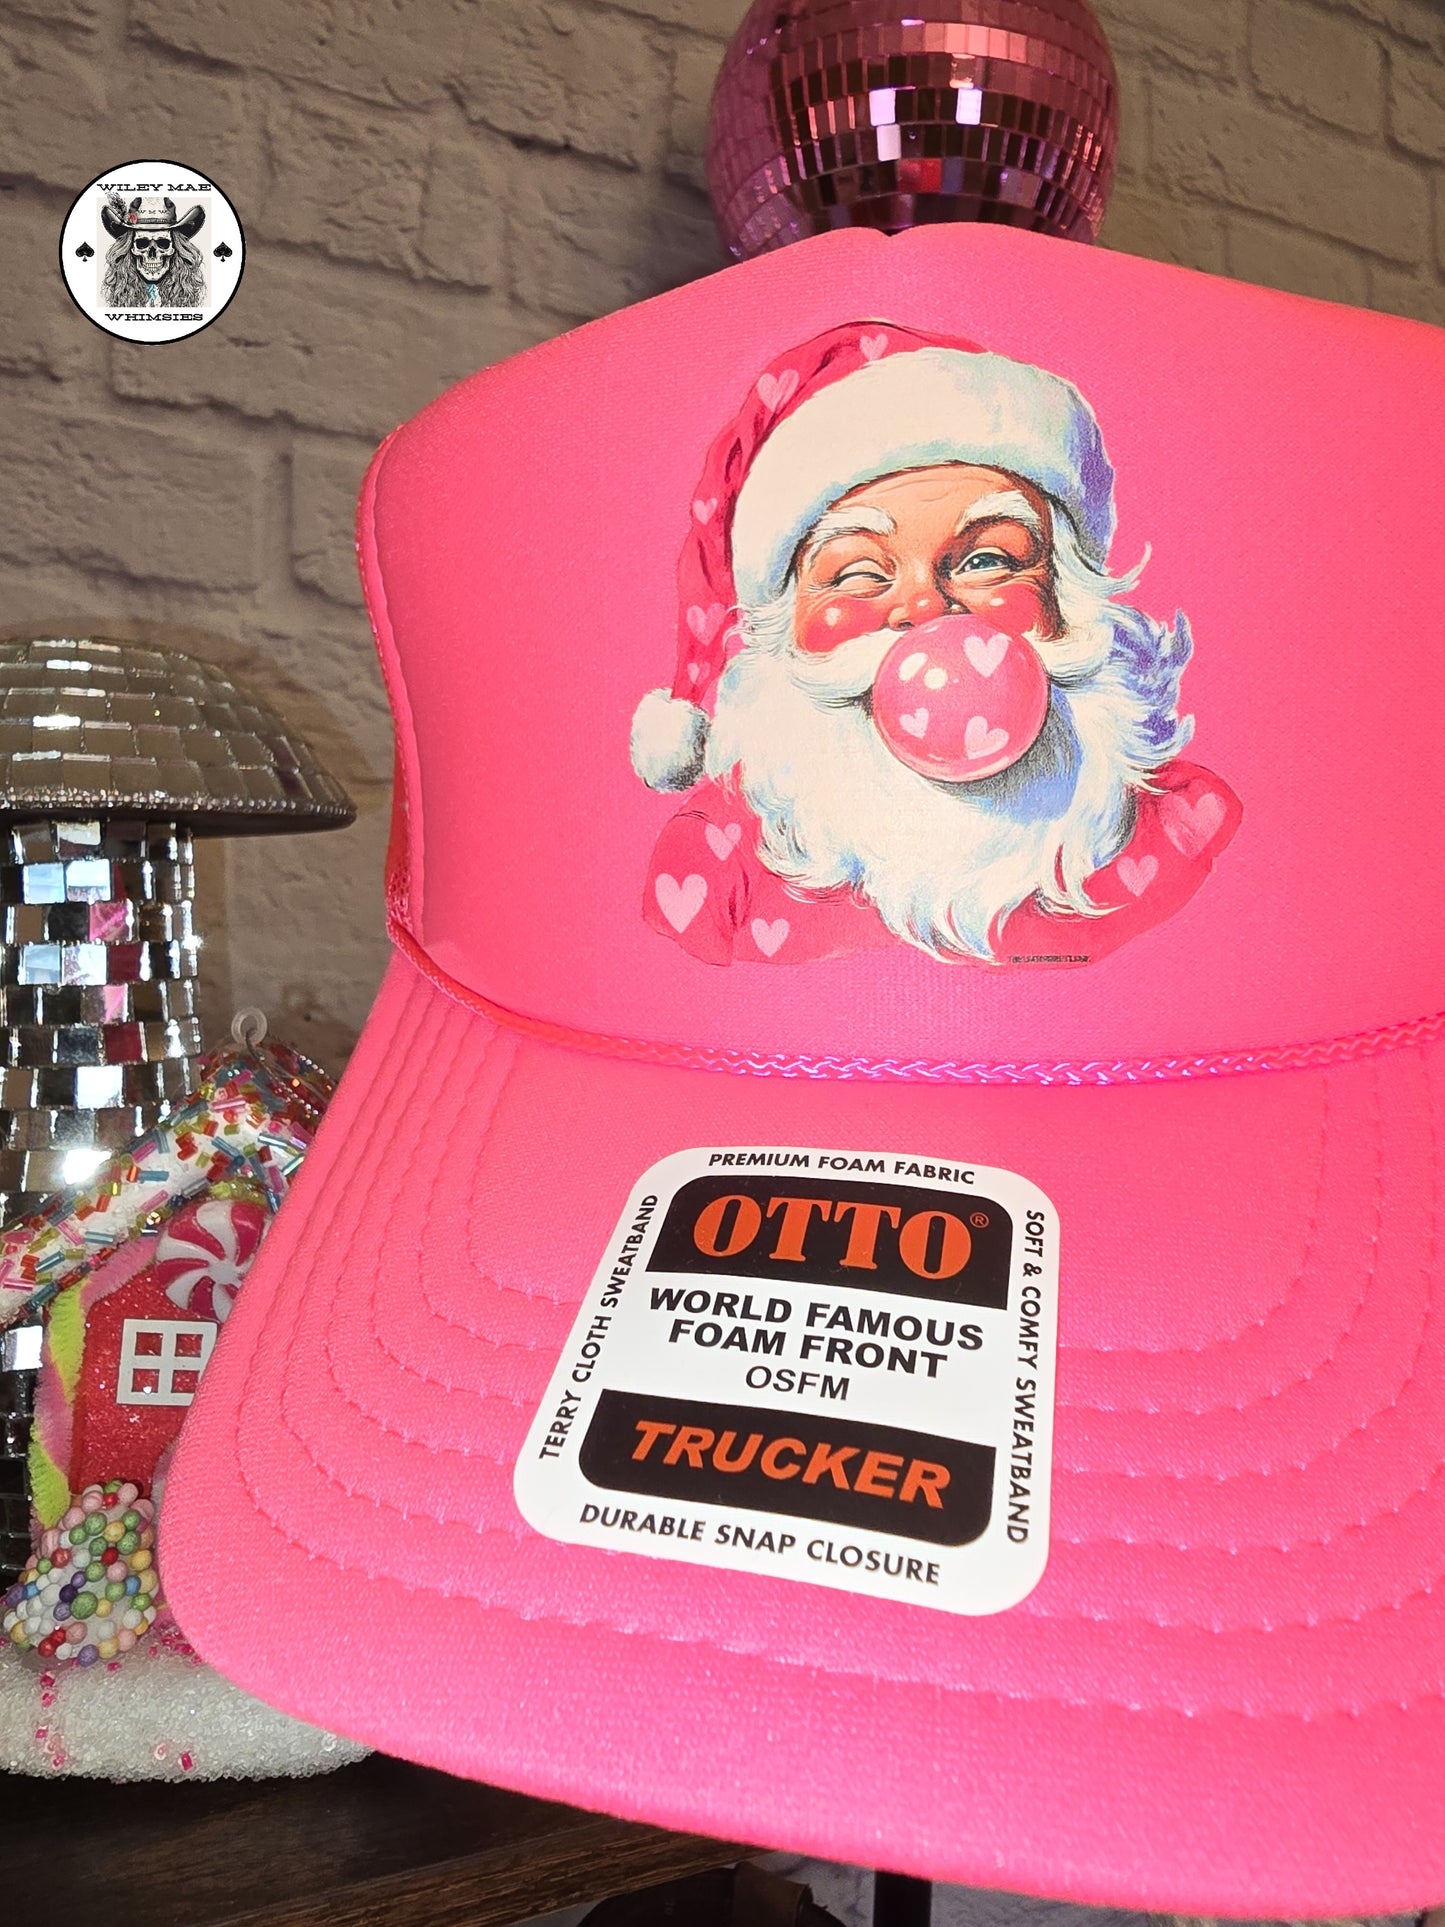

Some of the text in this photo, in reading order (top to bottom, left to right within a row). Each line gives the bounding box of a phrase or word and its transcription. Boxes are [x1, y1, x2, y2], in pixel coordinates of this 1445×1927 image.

[708, 1152, 975, 1184] PREMIUM FOAM FABRIC
[540, 1194, 658, 1460] TERRY CLOTH SWEATBAND
[649, 1287, 984, 1350] WORLD FAMOUS
[669, 1319, 948, 1378] FOAM FRONT
[746, 1366, 850, 1400] OSFM
[1007, 1210, 1045, 1543] SOFT & COMFY SWEATBAND
[631, 1421, 950, 1509] TRUCKER
[580, 1503, 941, 1585] DURABLE SNAP CLOSURE
